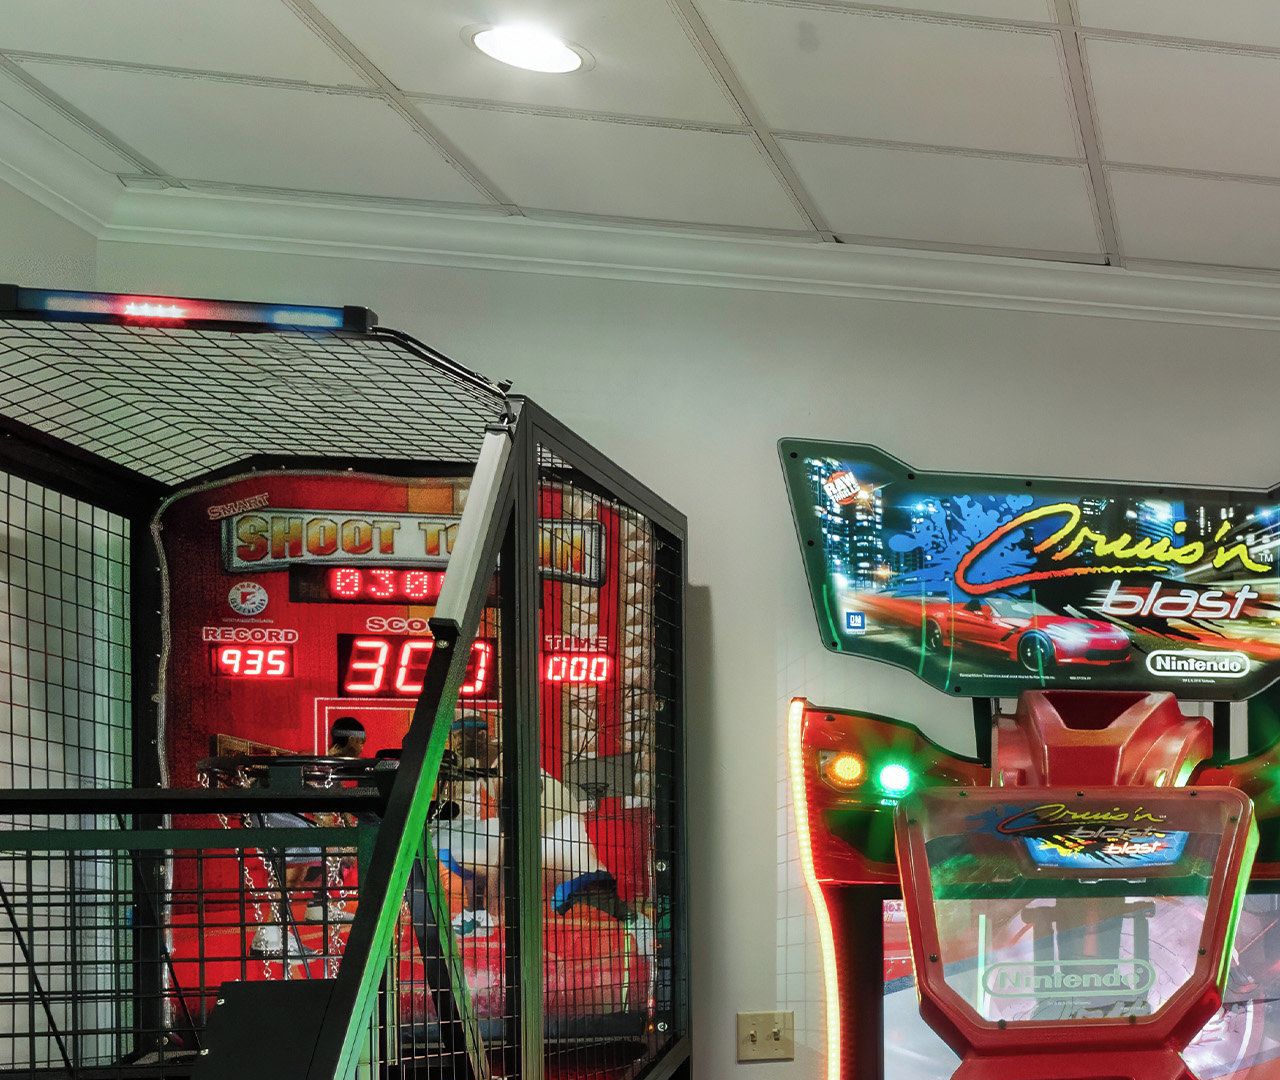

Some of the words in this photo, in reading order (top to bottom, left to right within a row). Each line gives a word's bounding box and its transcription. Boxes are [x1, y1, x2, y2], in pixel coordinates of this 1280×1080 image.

[207, 492, 270, 520] SMART
[236, 515, 400, 562] SHOOT
[957, 502, 1272, 594] Cruis'n
[1102, 579, 1260, 620] blast
[202, 626, 299, 643] RECORD
[366, 616, 432, 633] SCO
[221, 648, 286, 675] 935
[1155, 655, 1242, 672] Nintendo
[1104, 842, 1163, 855] blast
